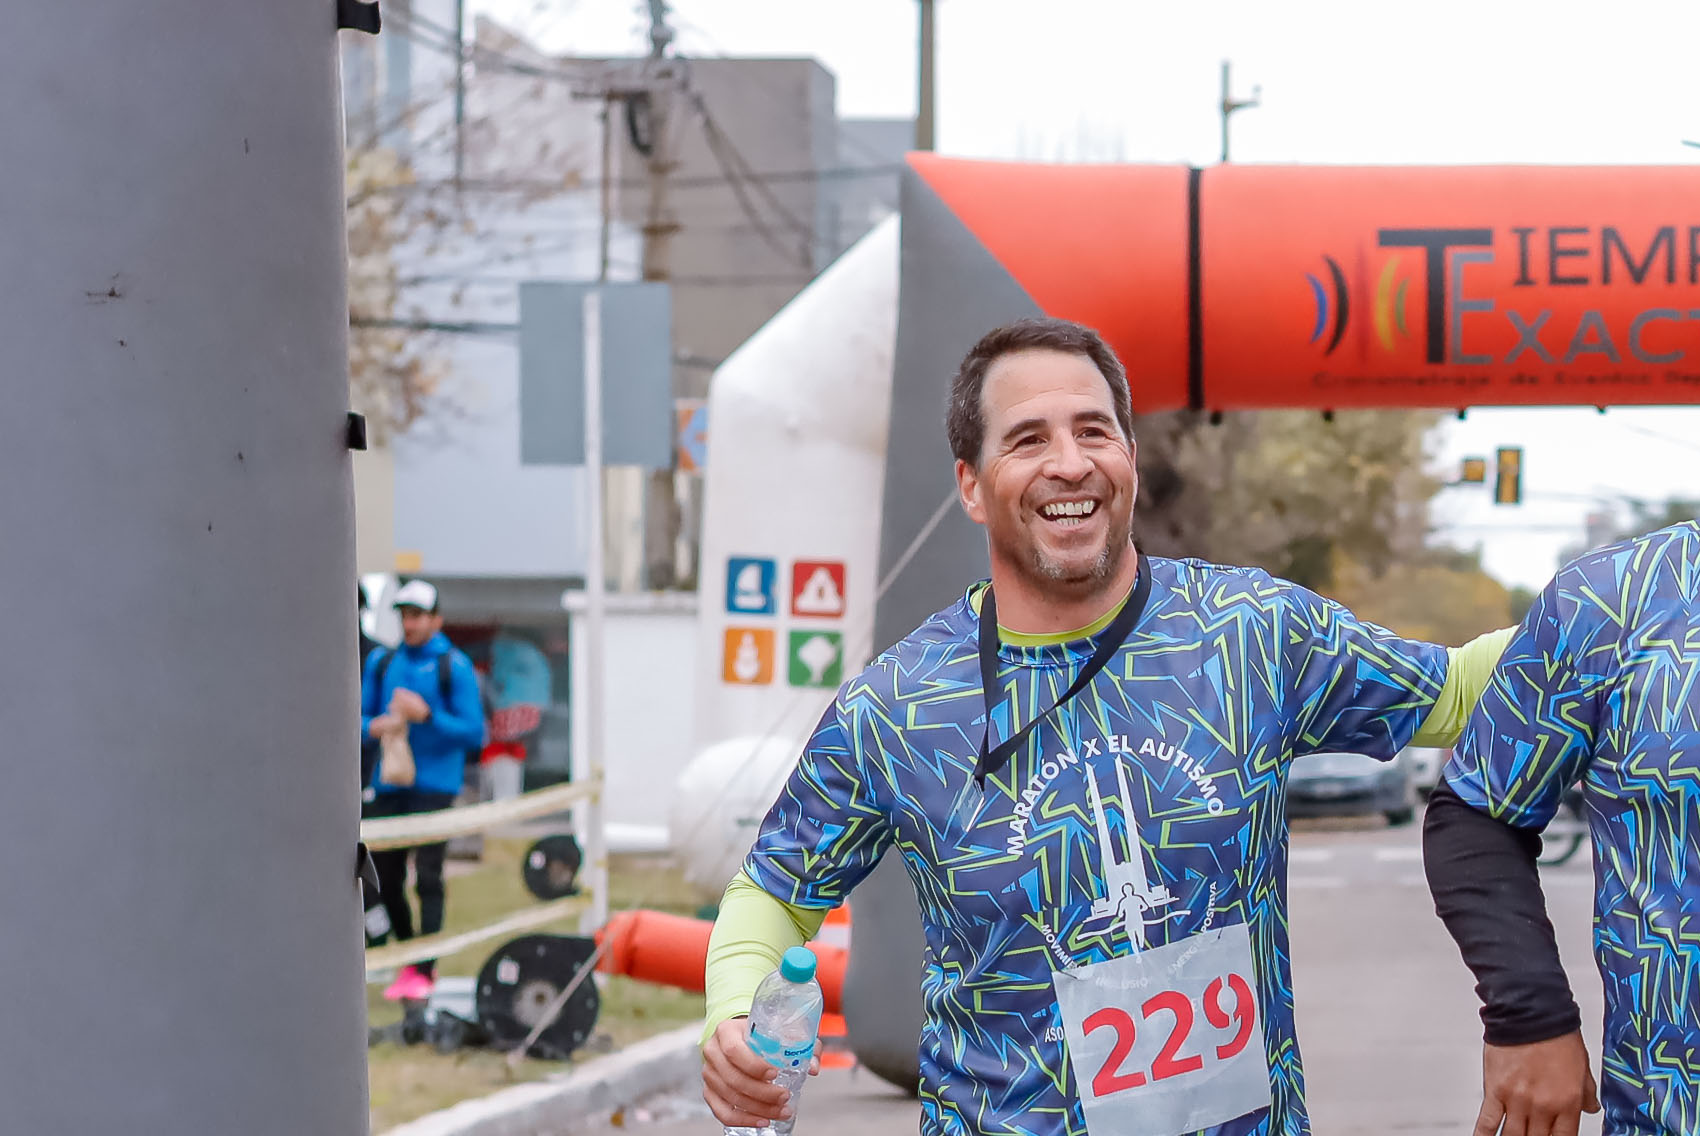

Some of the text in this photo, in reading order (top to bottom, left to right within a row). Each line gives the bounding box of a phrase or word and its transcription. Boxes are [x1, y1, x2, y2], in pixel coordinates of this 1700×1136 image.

[1006, 734, 1224, 856] MARATÓN X EL AUTISMO
[1081, 972, 1256, 1098] 229
